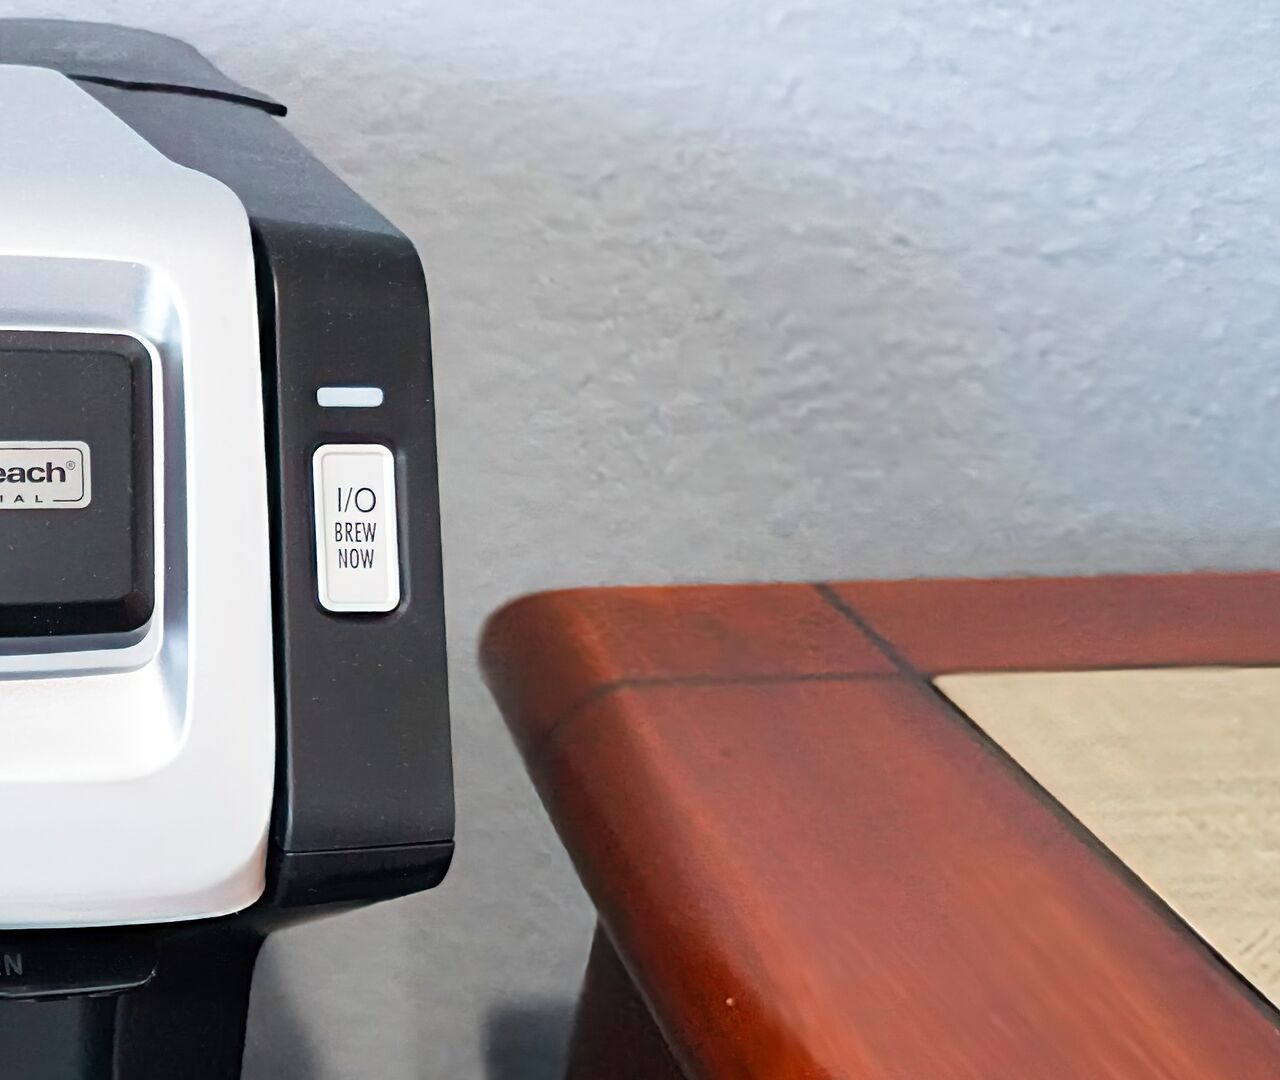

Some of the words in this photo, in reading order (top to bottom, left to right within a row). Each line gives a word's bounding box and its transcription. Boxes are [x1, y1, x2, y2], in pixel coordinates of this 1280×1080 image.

[337, 487, 377, 513] I/O
[334, 522, 377, 543] BREW
[338, 548, 375, 569] NOW
